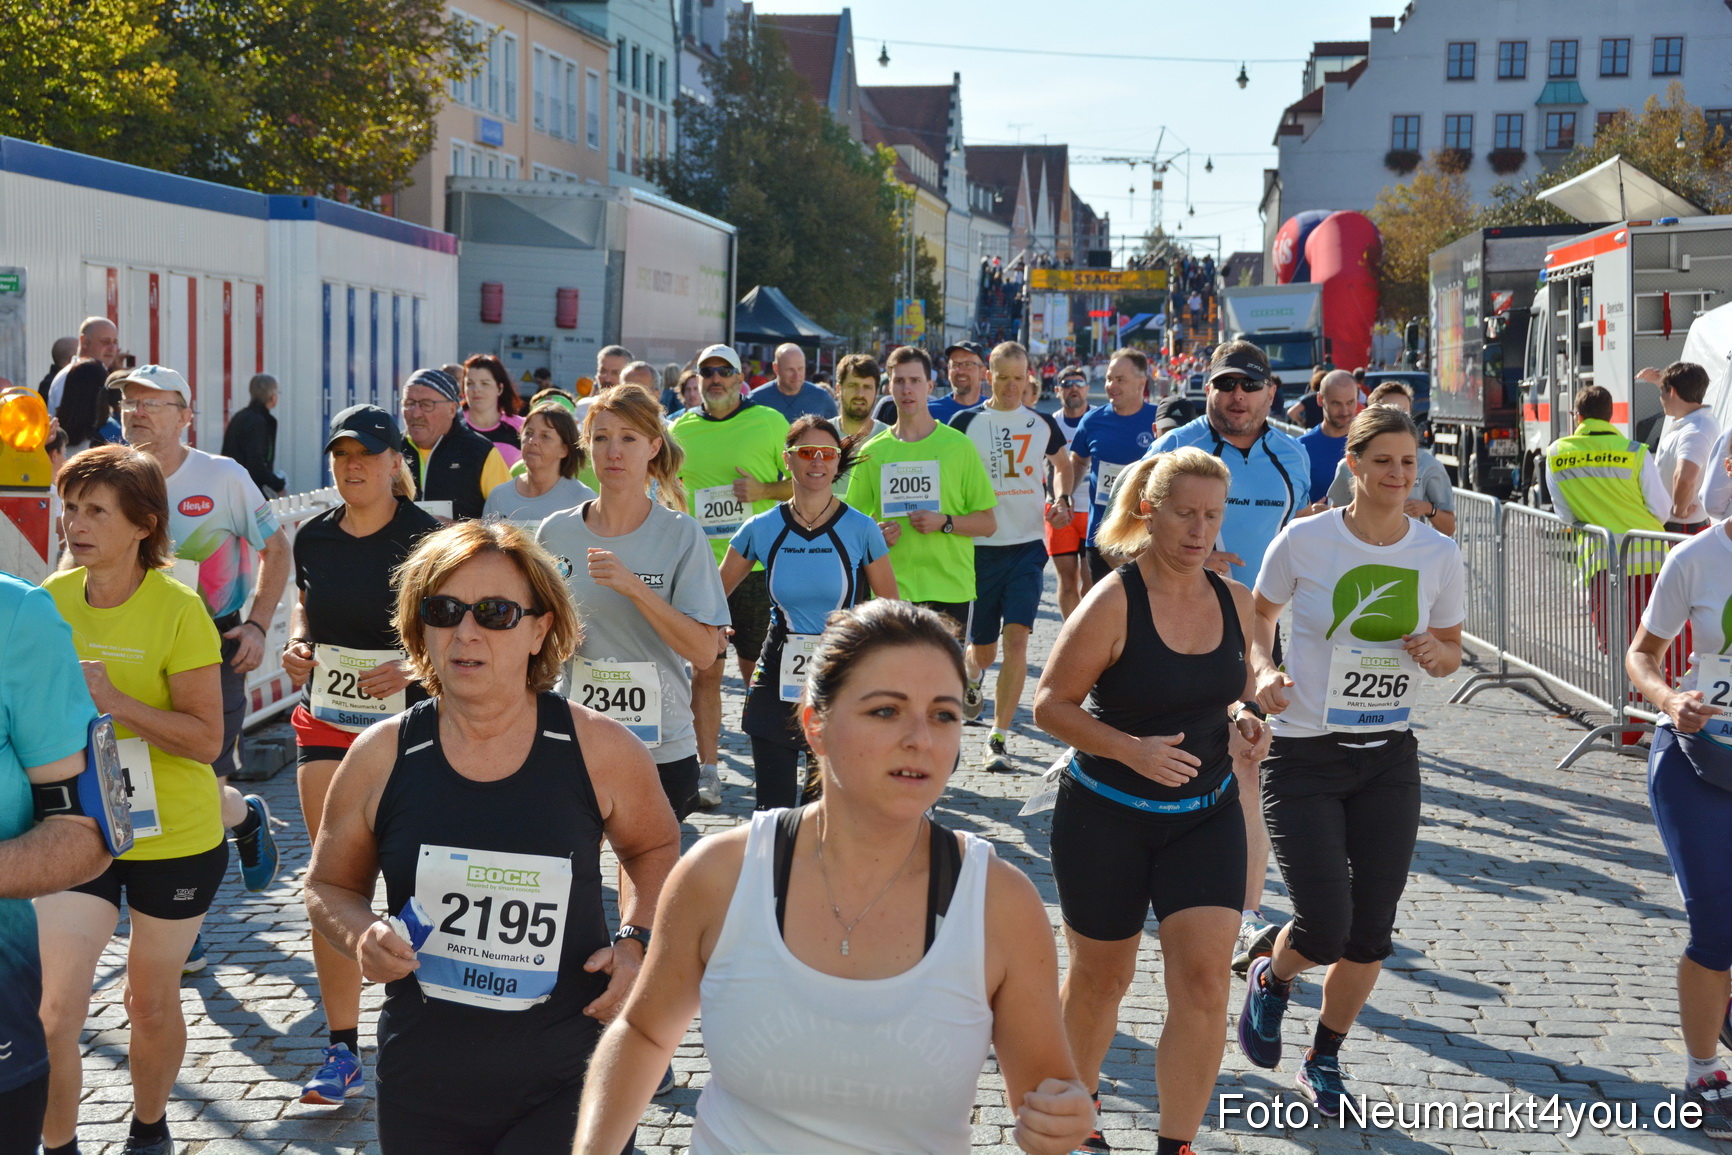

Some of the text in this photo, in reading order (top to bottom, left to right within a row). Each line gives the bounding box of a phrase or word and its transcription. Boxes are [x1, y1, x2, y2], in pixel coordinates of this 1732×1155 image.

[1074, 273, 1122, 285] START
[995, 435, 1003, 458] LAUF
[990, 450, 998, 479] STADT
[1556, 453, 1628, 467] Org.-Leiter
[890, 476, 931, 494] 2005
[182, 501, 211, 511] Hervis
[704, 500, 744, 518] 2004
[340, 654, 377, 668] BOCK
[1361, 656, 1400, 667] BOCK
[592, 668, 632, 680] BOCK
[1342, 671, 1410, 698] 2256
[332, 700, 349, 708] PARTL
[582, 684, 646, 712] 2340
[338, 712, 377, 725] Sabine
[1358, 713, 1384, 724] Anna
[467, 865, 540, 887] BOCK
[439, 892, 558, 948] 2195
[447, 943, 529, 963] PARTL Neumarkt
[463, 967, 517, 996] Helga
[760, 1069, 935, 1111] ATHLETICS
